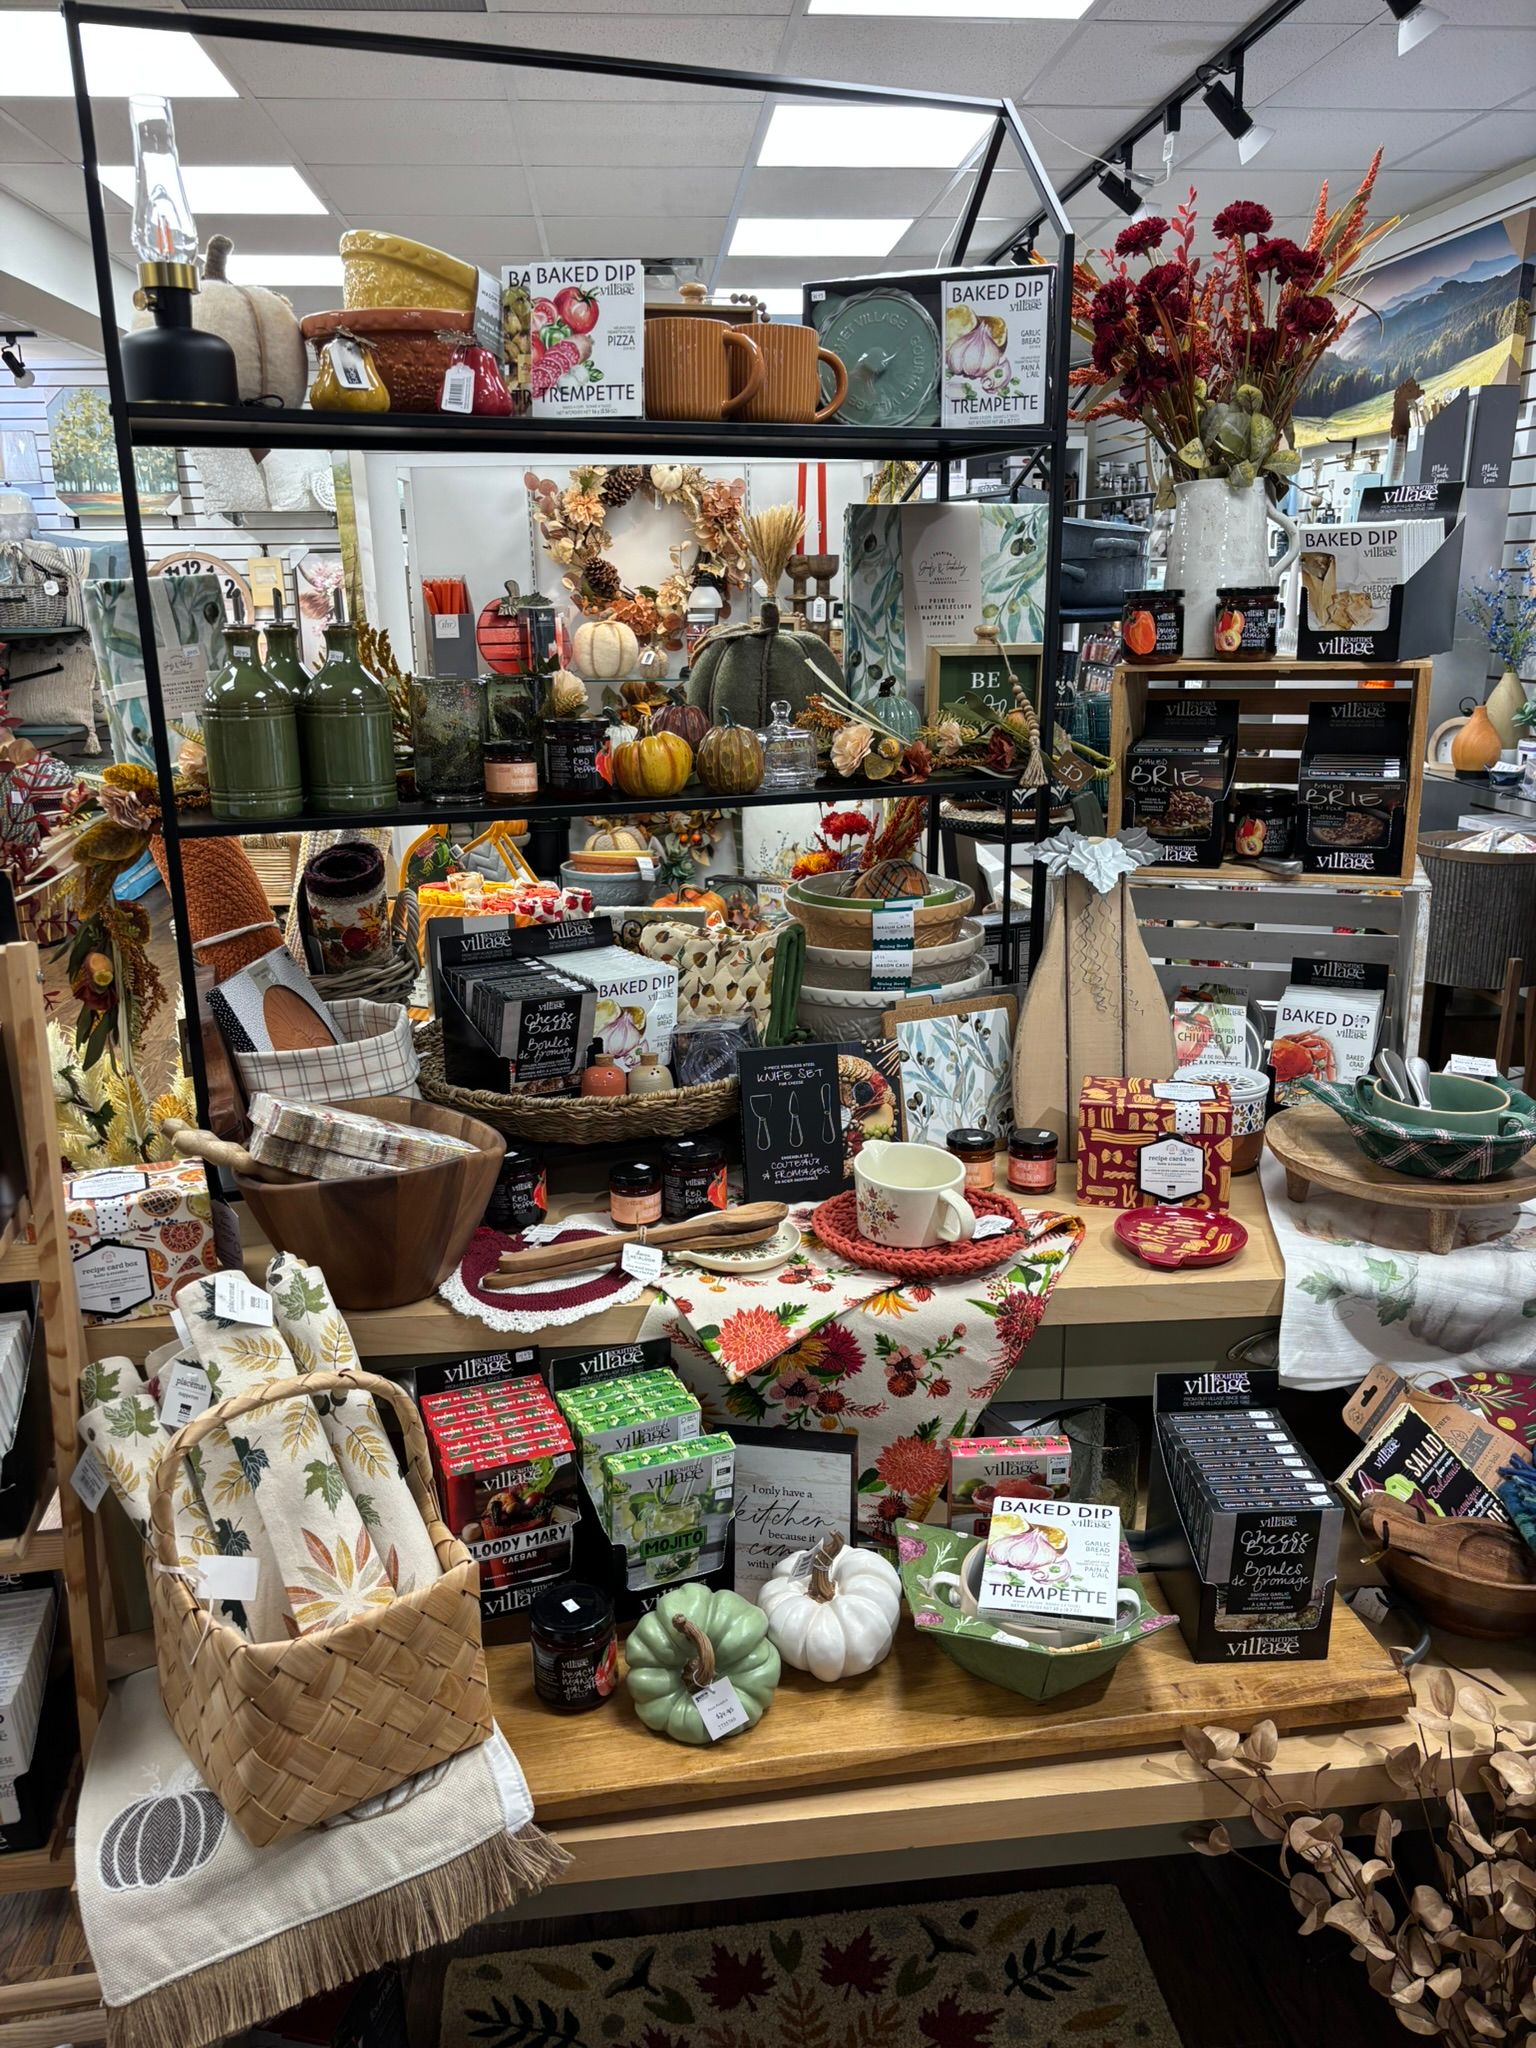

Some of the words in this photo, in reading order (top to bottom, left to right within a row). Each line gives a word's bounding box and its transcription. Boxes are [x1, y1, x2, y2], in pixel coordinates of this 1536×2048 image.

[537, 266, 599, 284] BAKED
[605, 265, 636, 282] DIP
[599, 284, 635, 296] village
[953, 284, 1009, 303] BAKED
[1016, 281, 1043, 298] DIP
[1009, 300, 1042, 312] village
[608, 335, 636, 346] PIZZA
[1021, 329, 1041, 337] GARLIC
[1021, 337, 1041, 345] BREAD
[1021, 364, 1034, 372] PAIN
[539, 384, 635, 403] TREMPETTE
[951, 395, 1038, 414] TREMPETTE
[1432, 464, 1448, 472] Made
[1482, 464, 1498, 472] Made
[1384, 486, 1438, 503] village
[1305, 531, 1362, 547] BAKED
[1368, 530, 1398, 545] DIP
[1363, 547, 1397, 558] village
[182, 560, 201, 576] 12
[224, 579, 236, 599] 2
[1318, 637, 1374, 655] village
[971, 672, 1000, 689] BE
[1166, 701, 1217, 717] village
[1331, 703, 1386, 718] village
[573, 758, 590, 766] RED
[1138, 758, 1168, 766] BAKED
[1128, 765, 1204, 787] BRIE
[1305, 789, 1383, 806] BRIE
[1317, 852, 1375, 870] village
[547, 922, 593, 939] village
[461, 933, 511, 951] village
[1312, 962, 1366, 979] village
[600, 980, 648, 998] BAKED
[652, 975, 675, 990] DIP
[538, 1000, 566, 1011] village
[525, 1012, 576, 1026] Cheese
[1282, 1007, 1337, 1025] BAKED
[528, 1021, 573, 1035] Balls
[1336, 1029, 1368, 1040] village
[527, 1036, 570, 1051] Boules
[1177, 1032, 1223, 1044] CHILLED
[1226, 1035, 1244, 1045] DIP
[519, 1050, 530, 1059] de
[534, 1047, 575, 1063] fromage
[757, 1070, 793, 1082] KNIFE
[798, 1068, 824, 1079] SET
[771, 1158, 820, 1170] COUTEAUX
[775, 1165, 831, 1179] FROMAGES
[512, 1195, 529, 1203] RED
[685, 1189, 702, 1198] RED
[82, 1265, 106, 1275] recipe
[106, 1262, 124, 1271] card
[228, 1282, 236, 1313] placemat
[610, 1344, 642, 1357] gourmet
[474, 1352, 508, 1366] gourmet
[580, 1349, 644, 1375] village
[445, 1357, 512, 1382] village
[1214, 1372, 1248, 1380] gourmet
[175, 1377, 208, 1391] placemat
[1184, 1373, 1251, 1394] village
[616, 1426, 671, 1450] village
[485, 1452, 507, 1460] VILLAGE
[512, 1446, 537, 1455] GOURMET
[547, 1439, 568, 1447] VILLAGE
[1374, 1437, 1401, 1470] village
[1404, 1433, 1443, 1478] SALAD
[510, 1463, 540, 1477] gourmet
[984, 1461, 1039, 1477] village
[482, 1465, 543, 1492] village
[647, 1467, 704, 1490] village
[1428, 1462, 1461, 1499] Balsamic
[752, 1484, 756, 1493] I
[759, 1486, 780, 1498] only
[783, 1487, 805, 1497] have
[733, 1495, 835, 1535] kitchen
[1000, 1500, 1071, 1517] BAKED
[1078, 1507, 1113, 1520] DIP
[1260, 1517, 1297, 1528] village
[526, 1525, 567, 1547] MARY
[644, 1530, 703, 1555] MOJITO
[768, 1530, 806, 1542] because
[809, 1534, 815, 1542] it
[1084, 1540, 1111, 1548] GARLIC
[1240, 1530, 1313, 1545] Cheese
[1244, 1540, 1307, 1556] Balls
[502, 1550, 537, 1564] CAESAR
[747, 1560, 769, 1569] with
[1084, 1566, 1103, 1574] PAIN
[1243, 1561, 1303, 1577] Boules
[1232, 1575, 1247, 1586] de
[1252, 1576, 1311, 1592] fromage
[989, 1583, 1108, 1605] TREMPETTE
[1228, 1637, 1300, 1656] village
[1261, 1635, 1299, 1644] gourmet
[562, 1666, 595, 1679] PEACH
